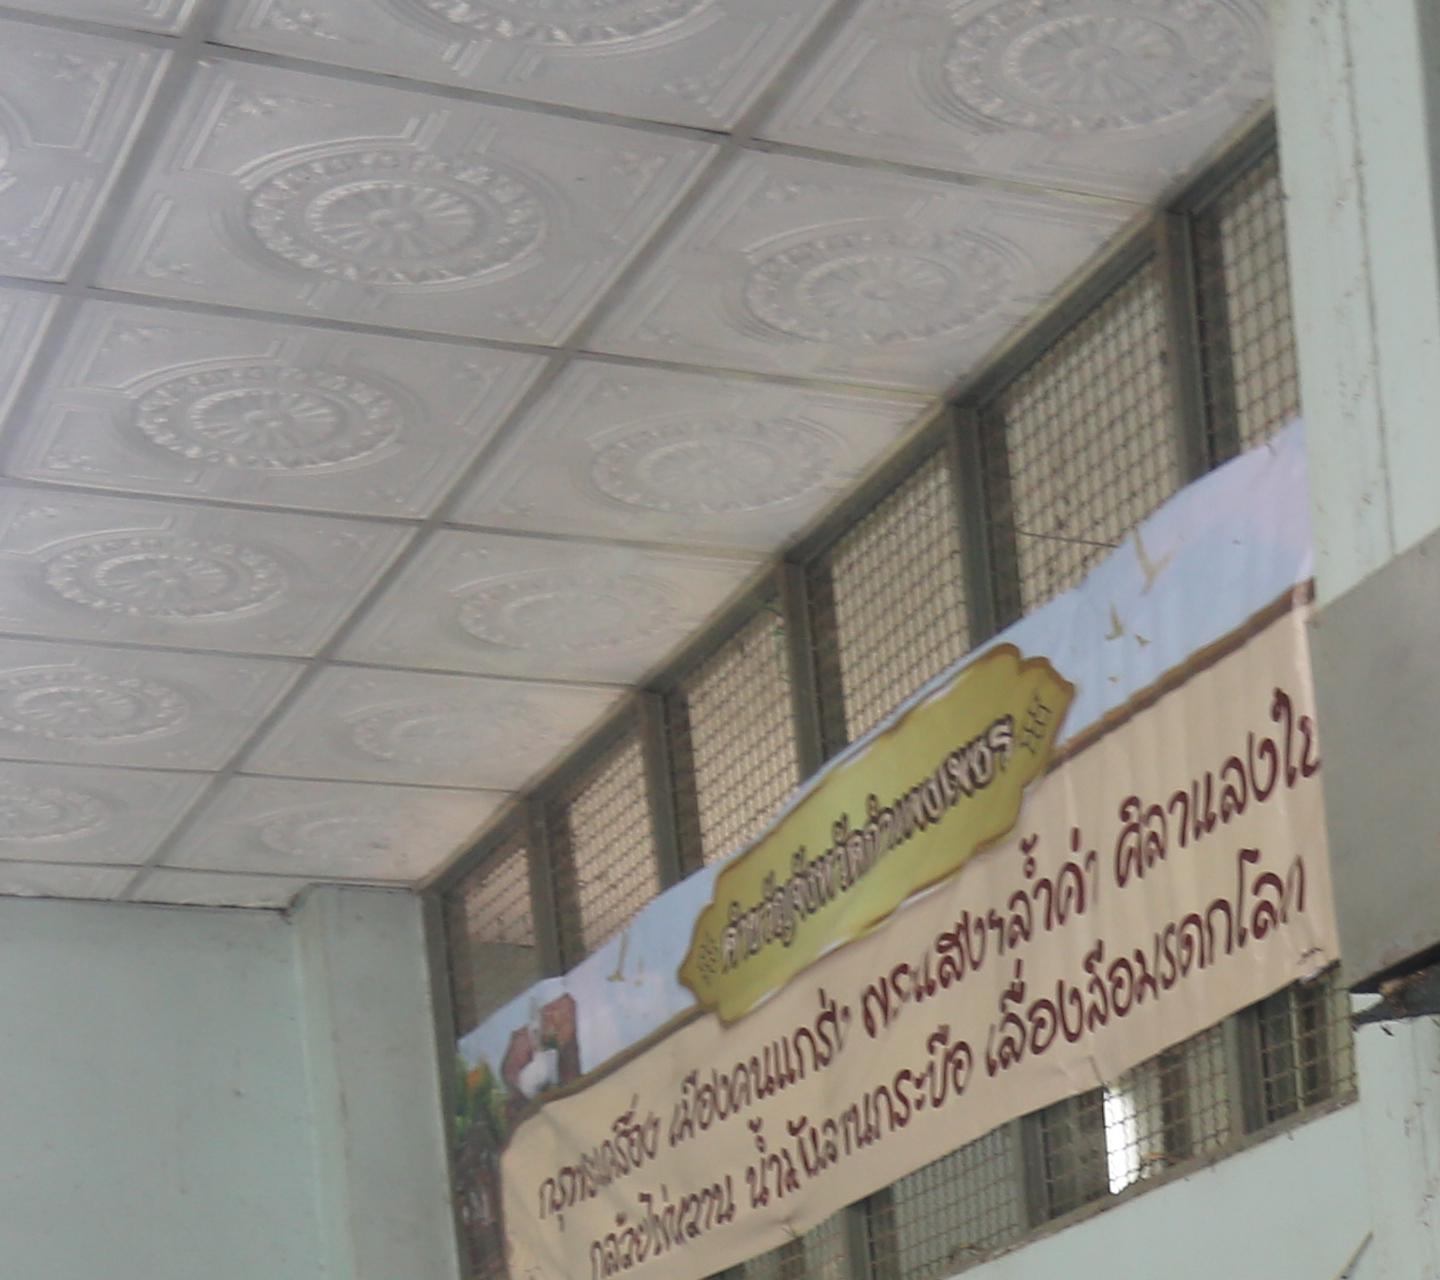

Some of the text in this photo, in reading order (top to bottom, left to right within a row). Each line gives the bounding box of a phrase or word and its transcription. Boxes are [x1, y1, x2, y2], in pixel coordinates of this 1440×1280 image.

[667, 986, 851, 1148] เมืองคนแกร่ง
[744, 1023, 974, 1209] น้ำมันลานกระบือ
[983, 846, 1305, 1078] เลื่องลือมรดกโลก
